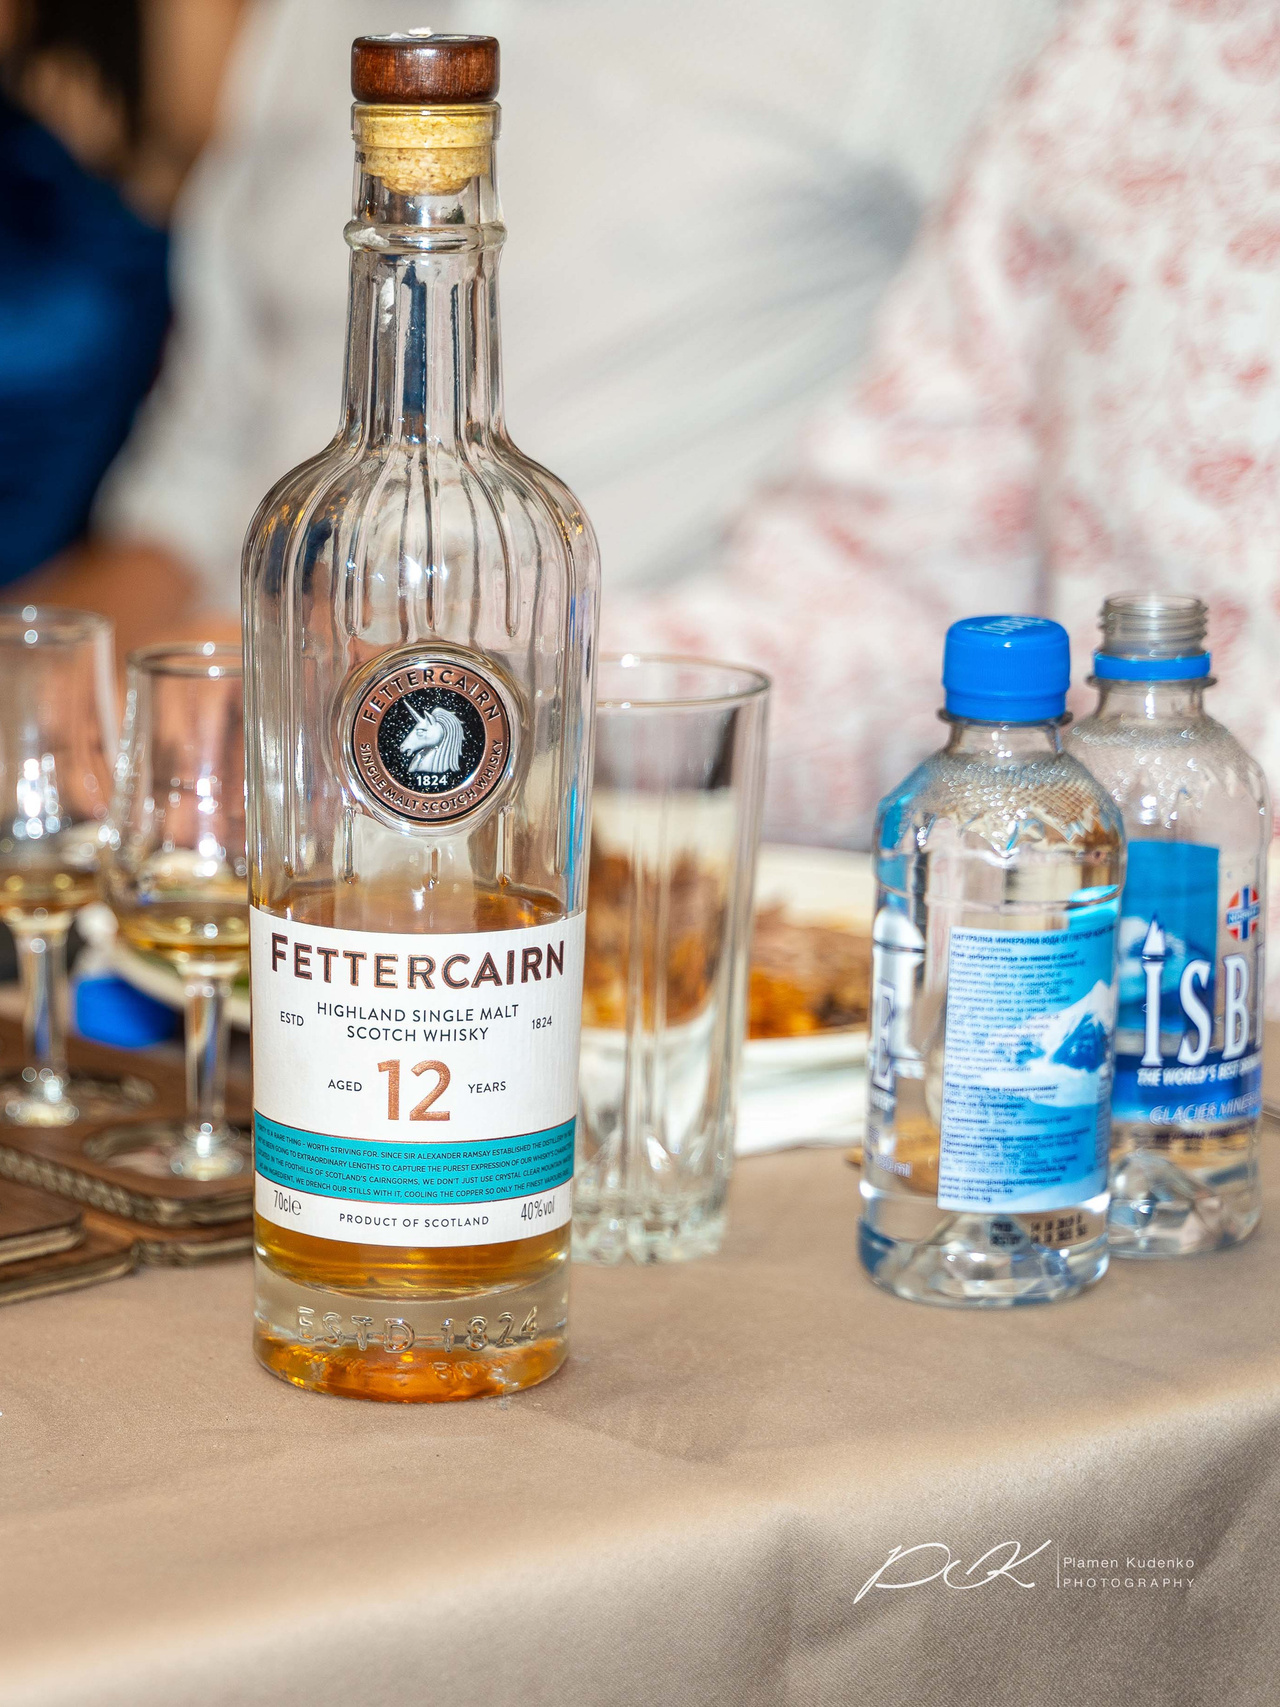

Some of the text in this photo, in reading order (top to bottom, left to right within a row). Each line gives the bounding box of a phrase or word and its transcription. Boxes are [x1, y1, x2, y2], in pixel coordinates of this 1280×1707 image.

[362, 669, 500, 724] FETTERCAIRN
[360, 740, 503, 813] SINGLE MALT SCOTCH WHISKY
[417, 775, 448, 786] 1824
[271, 932, 565, 990] FETTERCAIRN
[1141, 909, 1263, 1067] ISB
[280, 1011, 305, 1027] ESTD
[317, 1001, 519, 1023] HIGHLAND SINGLE MALT
[531, 1015, 553, 1030] 1824
[346, 1025, 489, 1042] SCOTCH WHISKY
[328, 1079, 363, 1092] AGED
[377, 1059, 451, 1121] 12
[467, 1080, 507, 1094] YEARS
[275, 1144, 289, 1157] GOING
[290, 1149, 297, 1158] TO
[297, 1152, 348, 1169] EXTRAORDINARY
[348, 1161, 380, 1171] LENGTHS
[381, 1164, 391, 1172] TO
[392, 1164, 426, 1173] CAPTURE
[427, 1164, 441, 1173] THE
[442, 1164, 470, 1172] PUREST
[470, 1160, 510, 1171] EXPRESSION
[511, 1158, 520, 1167] OF
[520, 1156, 532, 1165] OUR
[286, 1136, 301, 1147] THING
[306, 1141, 329, 1152] WORTH
[330, 1146, 361, 1156] STRIVING
[362, 1150, 379, 1158] FOR.
[380, 1151, 402, 1159] SINCE
[403, 1152, 416, 1160] SIR
[416, 1151, 462, 1160] ALEXANDER
[462, 1150, 491, 1159] RAMSAY
[491, 1143, 531, 1157] ESTABLISHED
[532, 1141, 542, 1150] THE
[268, 1167, 295, 1184] INGREDIENT,
[295, 1177, 305, 1186] WE
[305, 1179, 331, 1191] DRENCH
[332, 1184, 347, 1193] OUR
[348, 1186, 371, 1196] STILLS
[372, 1189, 393, 1197] WITH
[394, 1190, 402, 1199] IT,
[404, 1190, 438, 1199] COOLING
[440, 1190, 454, 1198] THE
[455, 1187, 484, 1198] COPPER
[485, 1187, 495, 1195] SO
[495, 1184, 513, 1195] ONLY
[514, 1181, 525, 1192] THE
[525, 1178, 544, 1190] FINEST
[284, 1161, 314, 1175] FOOTHILLS
[314, 1168, 323, 1177] OF
[325, 1171, 367, 1183] SCOTLAND'S
[368, 1175, 421, 1186] CAIRNGORMS,
[422, 1178, 435, 1186] WE
[436, 1177, 460, 1186] DON'T
[461, 1176, 478, 1185] JUST
[480, 1174, 493, 1183] USE
[494, 1171, 521, 1182] CRYSTAL
[522, 1166, 540, 1177] CLEAR
[339, 1213, 490, 1229] PRODUCT OF SCOTLAND
[297, 1306, 540, 1354] ESTD 1824
